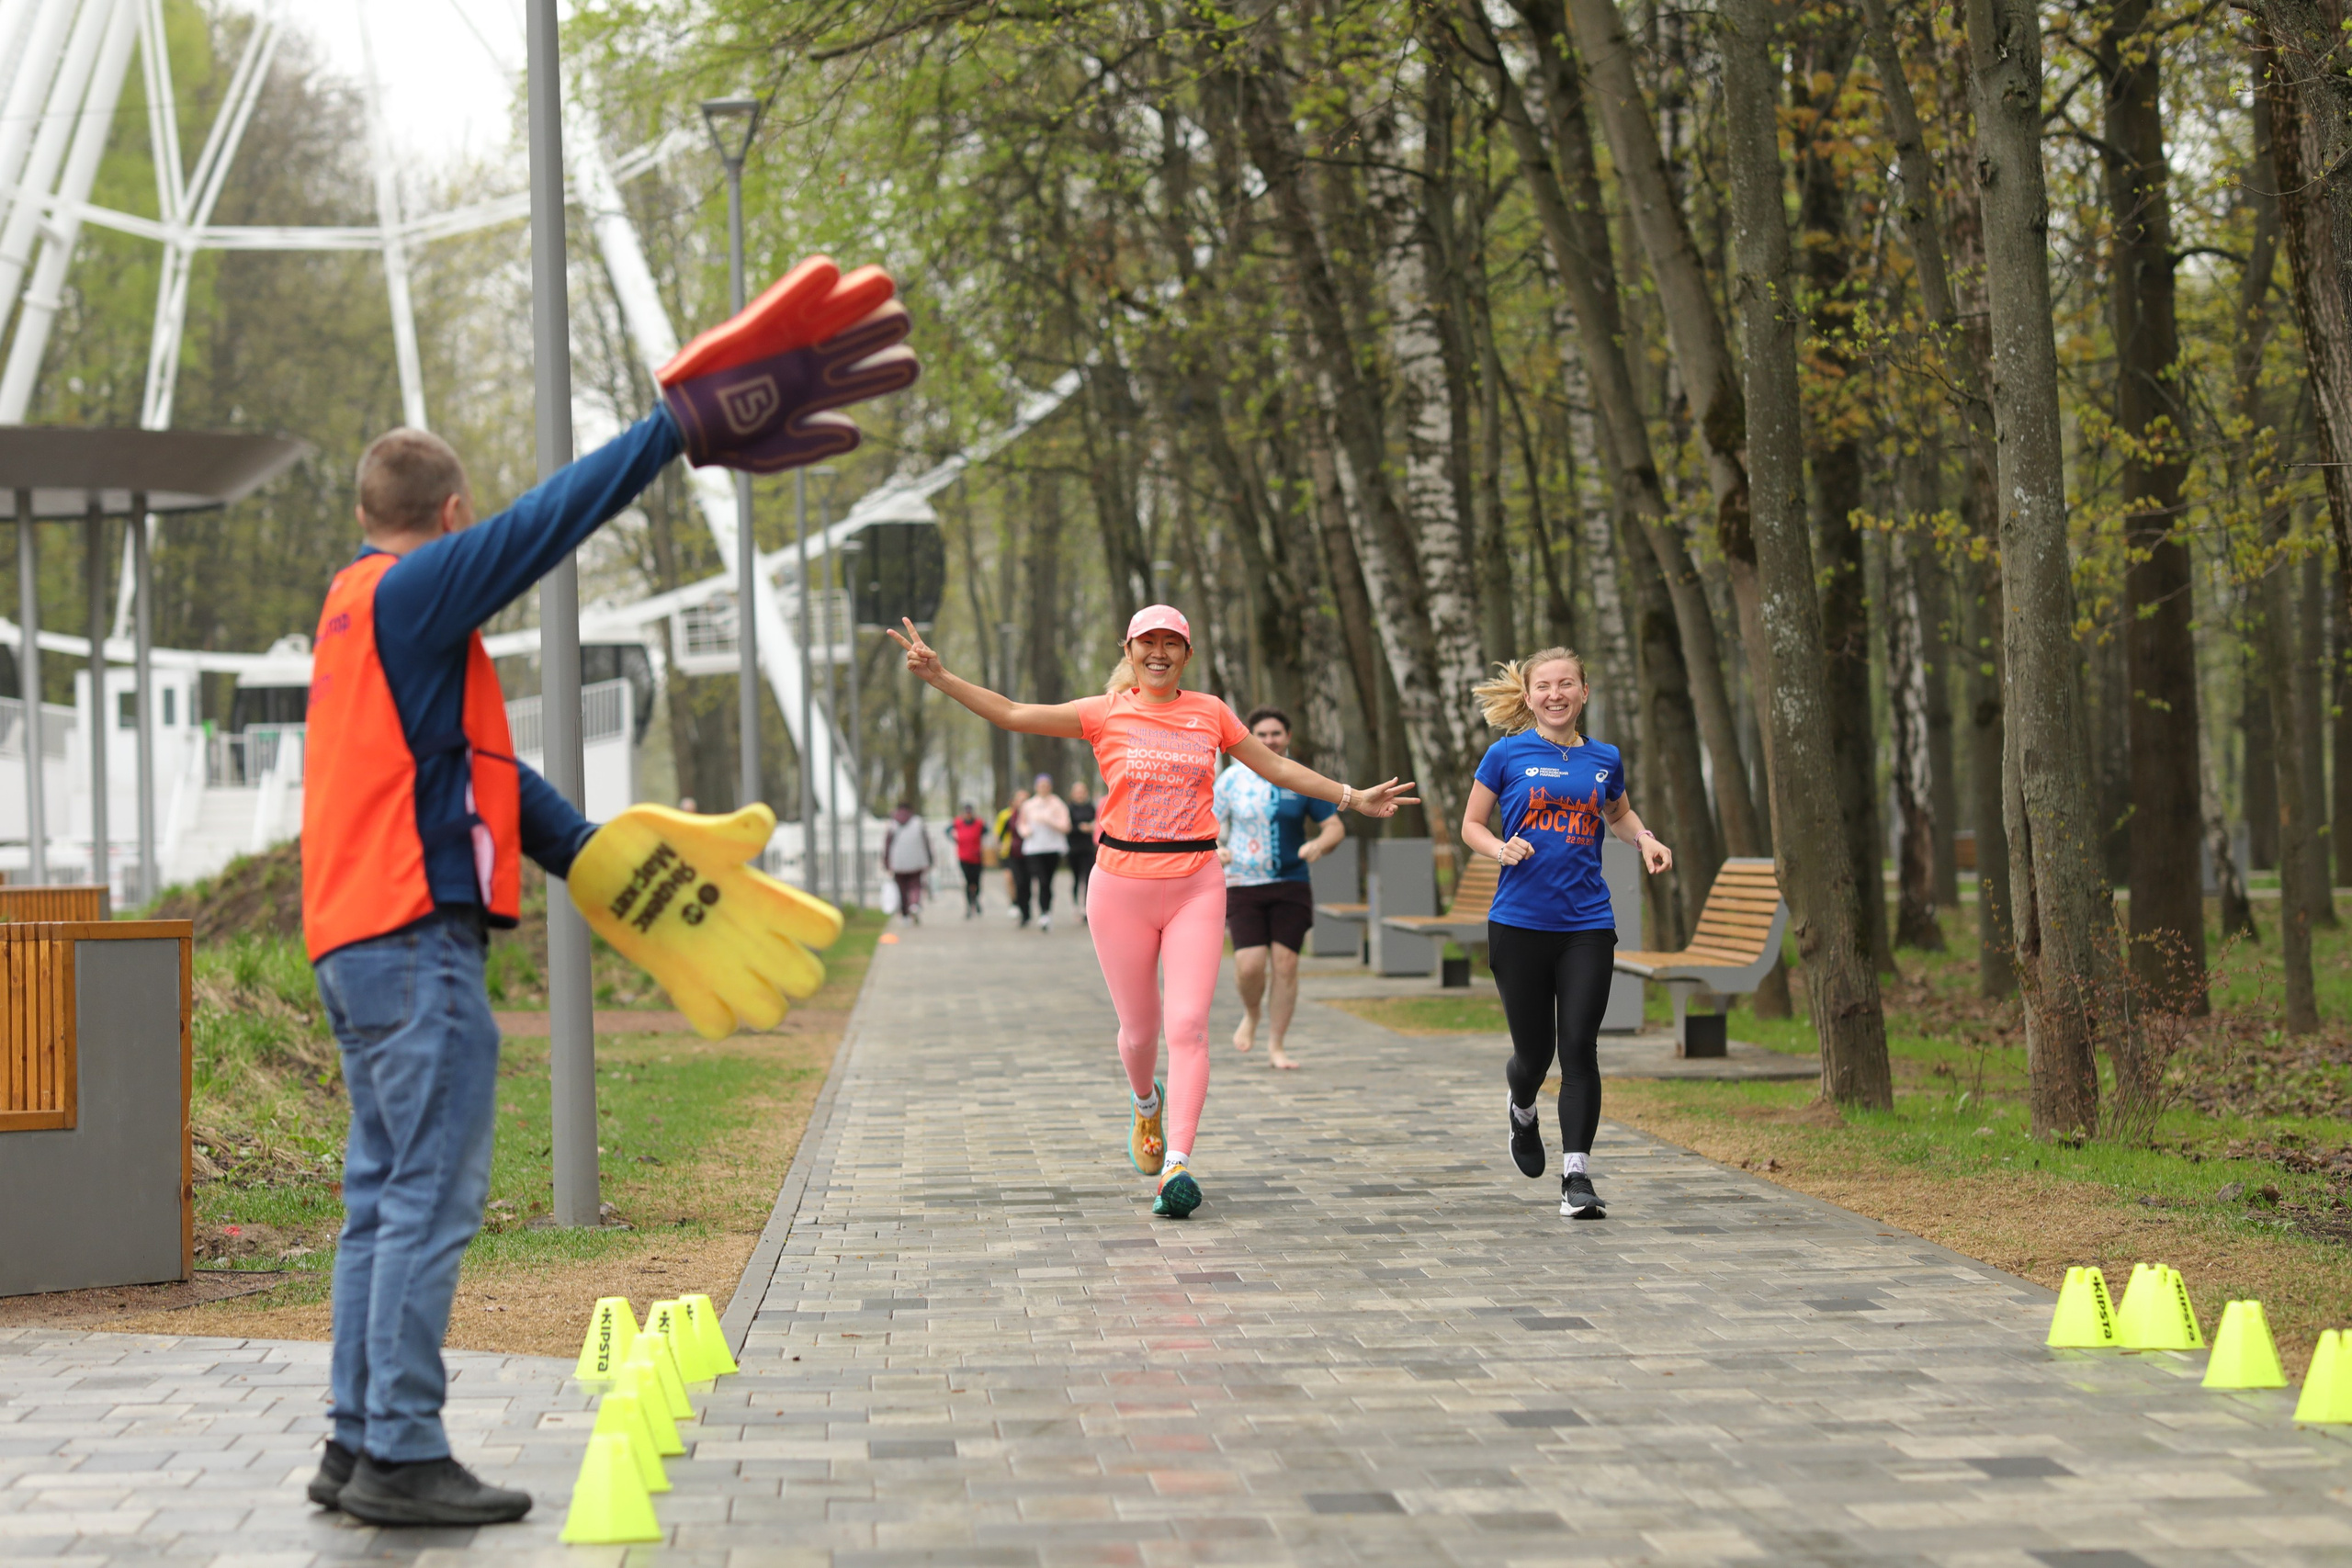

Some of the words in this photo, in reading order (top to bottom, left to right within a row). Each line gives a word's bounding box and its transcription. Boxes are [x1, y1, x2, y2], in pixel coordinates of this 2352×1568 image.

[1125, 760, 1160, 771] ПОЛУ
[1126, 748, 1210, 766] МОСКОВСКИЙ
[1125, 771, 1185, 784] МАРАФОН
[1520, 809, 1600, 837] МОСКВА
[609, 842, 677, 919] Маркет
[631, 860, 696, 933] Яндекс
